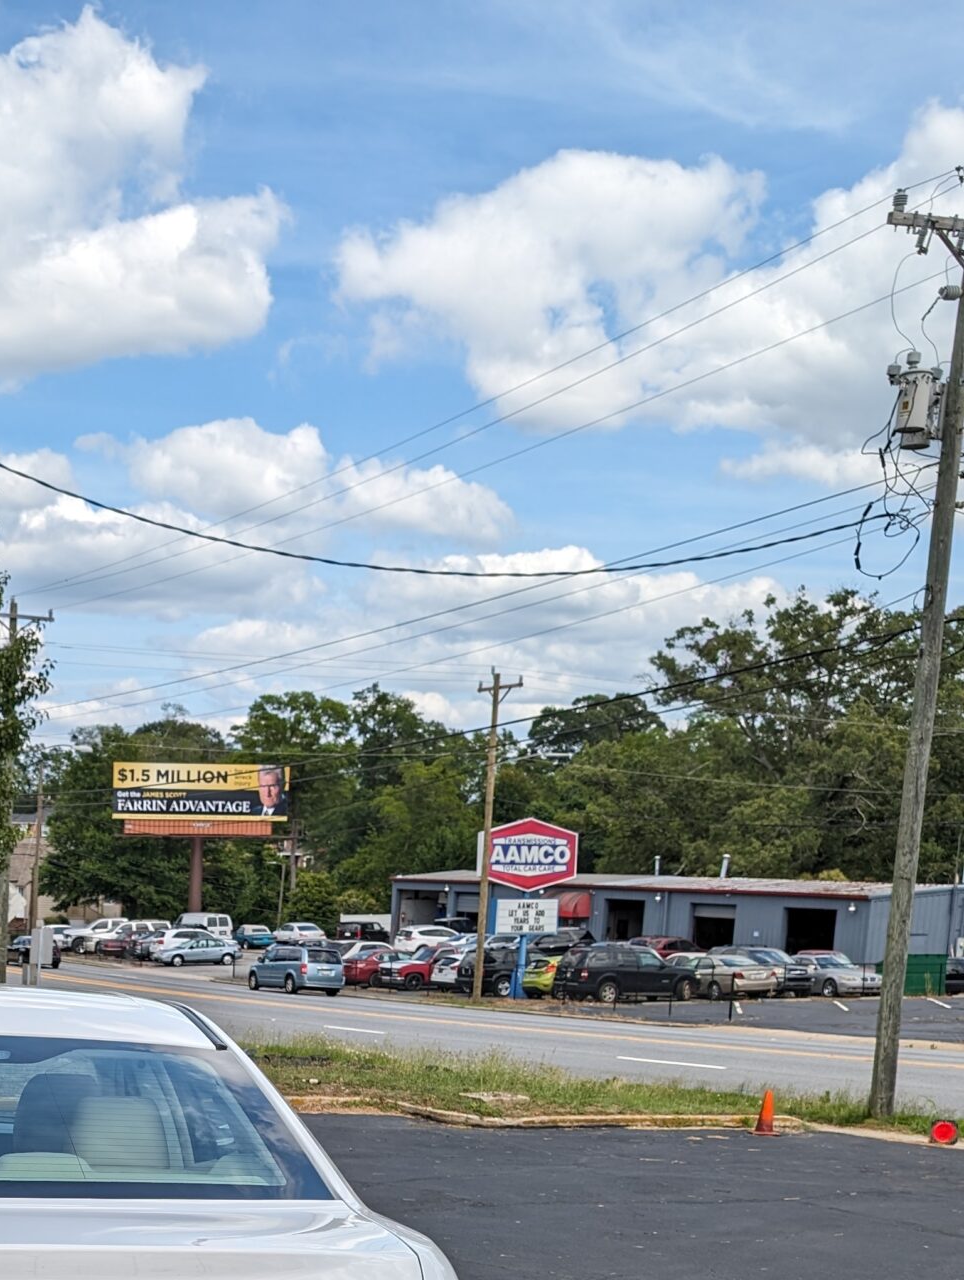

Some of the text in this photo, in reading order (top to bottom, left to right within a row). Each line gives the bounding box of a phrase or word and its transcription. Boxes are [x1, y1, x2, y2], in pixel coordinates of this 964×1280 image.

[117, 767, 228, 784] $1.5 MILLION
[117, 790, 129, 798] Get
[130, 790, 141, 798] the
[165, 791, 187, 799] SCOTT
[117, 799, 251, 813] FARRIN ADVANTAGE
[504, 837, 556, 845] TRANSMISSIONS
[490, 845, 571, 864] AAMCO
[508, 909, 518, 917] LET
